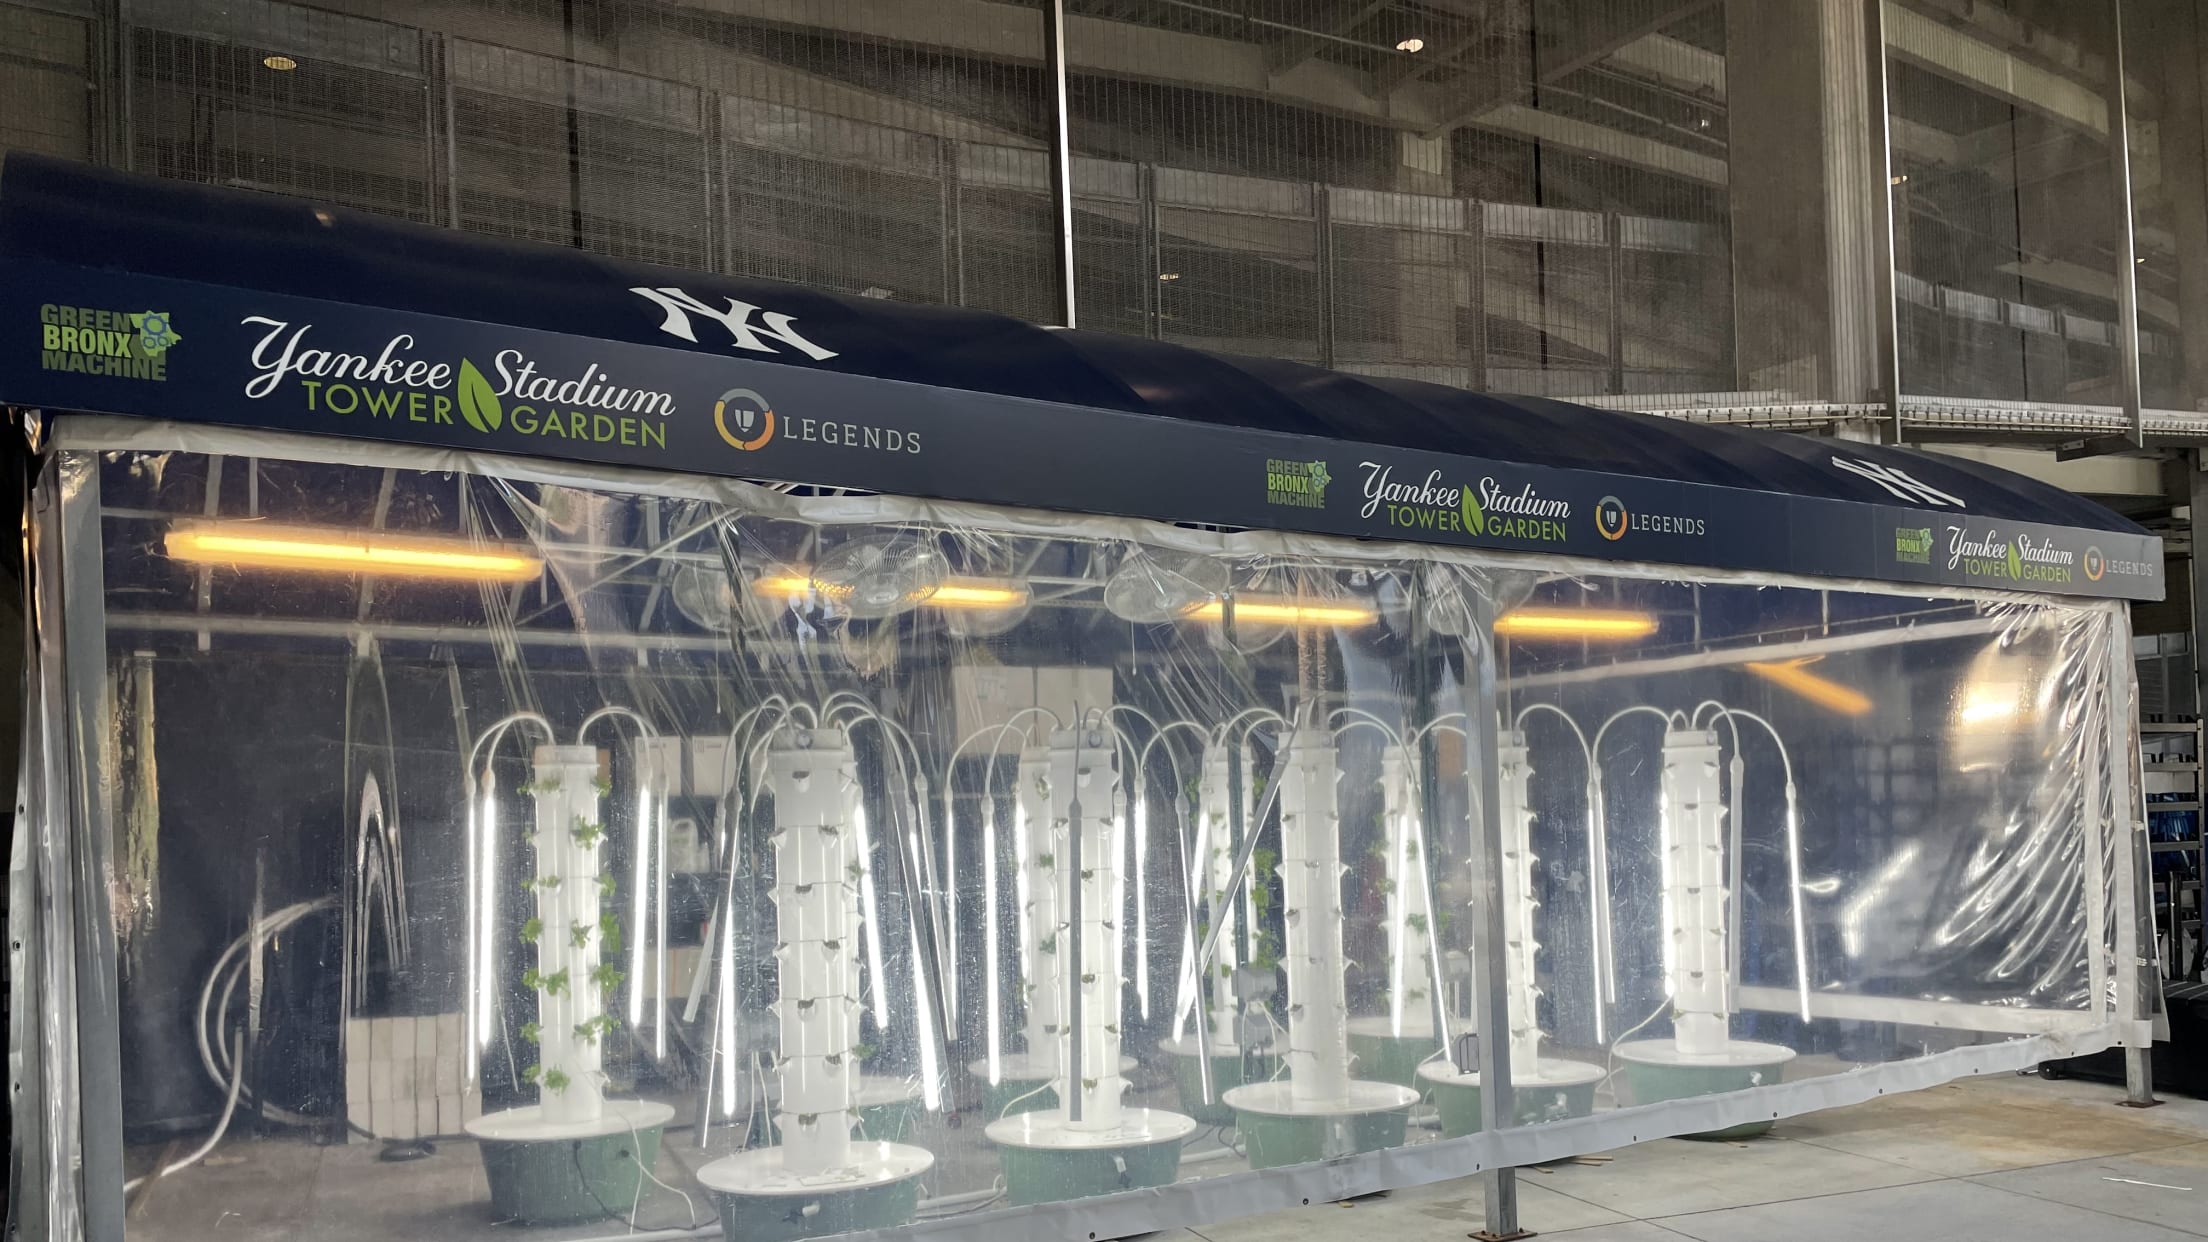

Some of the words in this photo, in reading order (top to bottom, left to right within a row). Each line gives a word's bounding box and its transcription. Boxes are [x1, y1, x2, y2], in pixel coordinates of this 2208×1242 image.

[40, 303, 131, 332] GREEN
[42, 324, 132, 358] BRONX
[41, 350, 167, 381] MACHINE
[240, 316, 453, 399] Yankee
[494, 349, 676, 416] Stadium
[302, 380, 454, 424] TOWER
[510, 405, 667, 450] GARDEN
[783, 416, 921, 454] LEGENDS
[1266, 459, 1309, 476] GREEN
[1267, 474, 1309, 494] BRONX
[1267, 489, 1325, 509] MACHINE
[1358, 461, 1460, 518] Yankee
[1479, 476, 1571, 519] Stadium
[1389, 504, 1461, 532] TOWER
[1487, 515, 1567, 543] GARDEN
[1631, 514, 1705, 536] LEGENDS
[1896, 538, 1920, 553] BRONX
[1946, 526, 2007, 570] Yankee
[2018, 534, 2074, 565] Stadium
[1963, 558, 2008, 578] TOWER
[2023, 565, 2071, 583] GARDEN
[2105, 560, 2153, 577] LEGENDS
